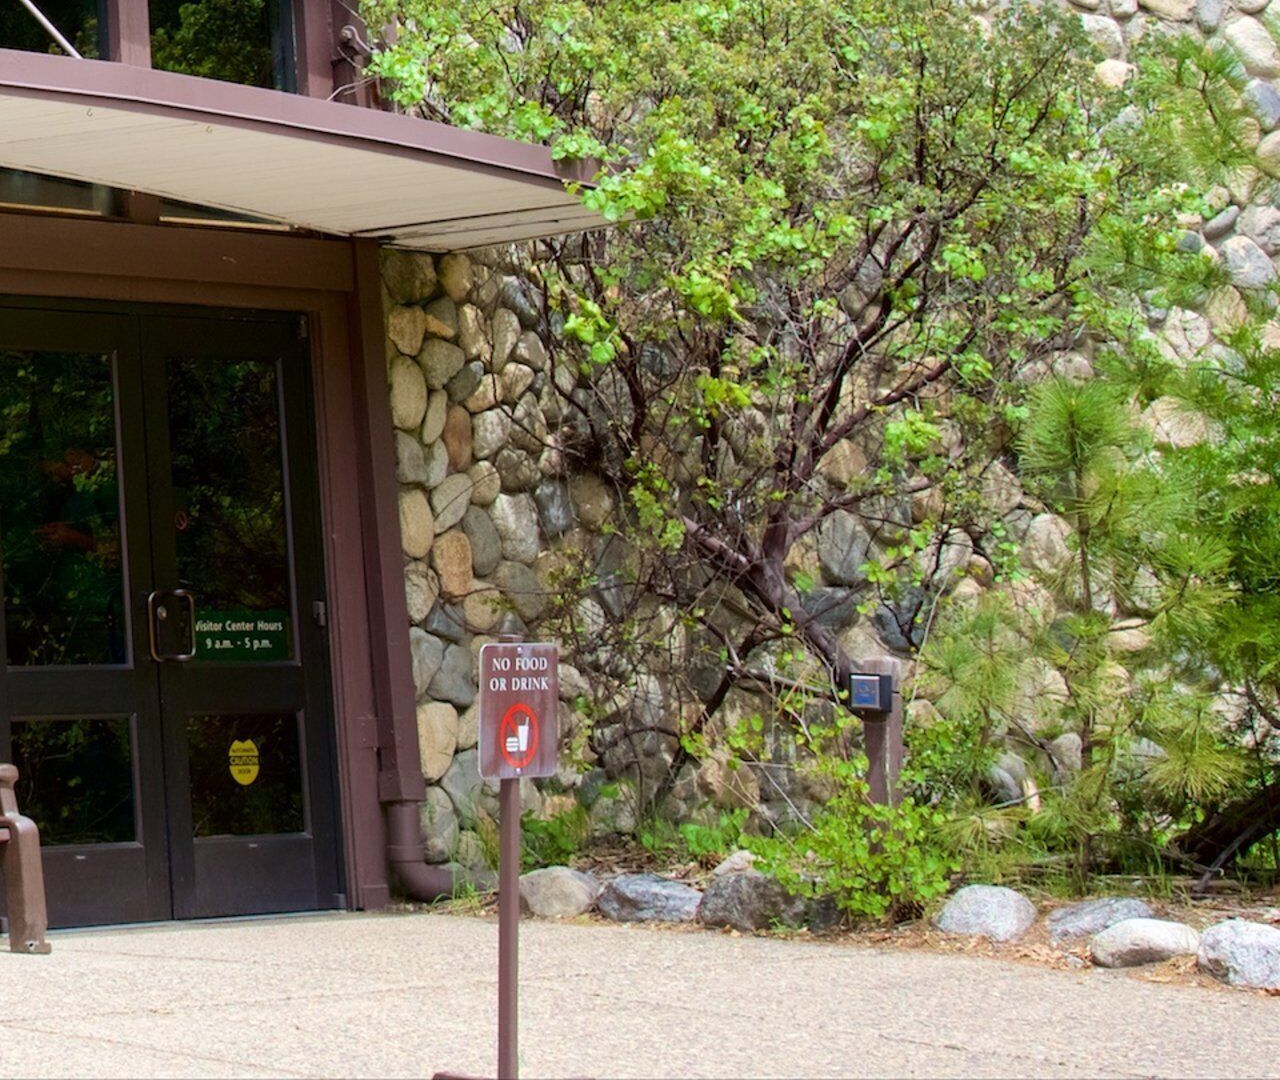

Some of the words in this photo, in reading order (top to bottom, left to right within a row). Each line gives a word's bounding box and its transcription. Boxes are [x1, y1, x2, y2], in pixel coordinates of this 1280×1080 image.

[225, 621, 254, 632] Center
[257, 621, 283, 631] Hours
[492, 657, 510, 671] NO
[515, 657, 548, 671] FOOD
[490, 677, 507, 691] OR
[512, 677, 549, 691] DRINK
